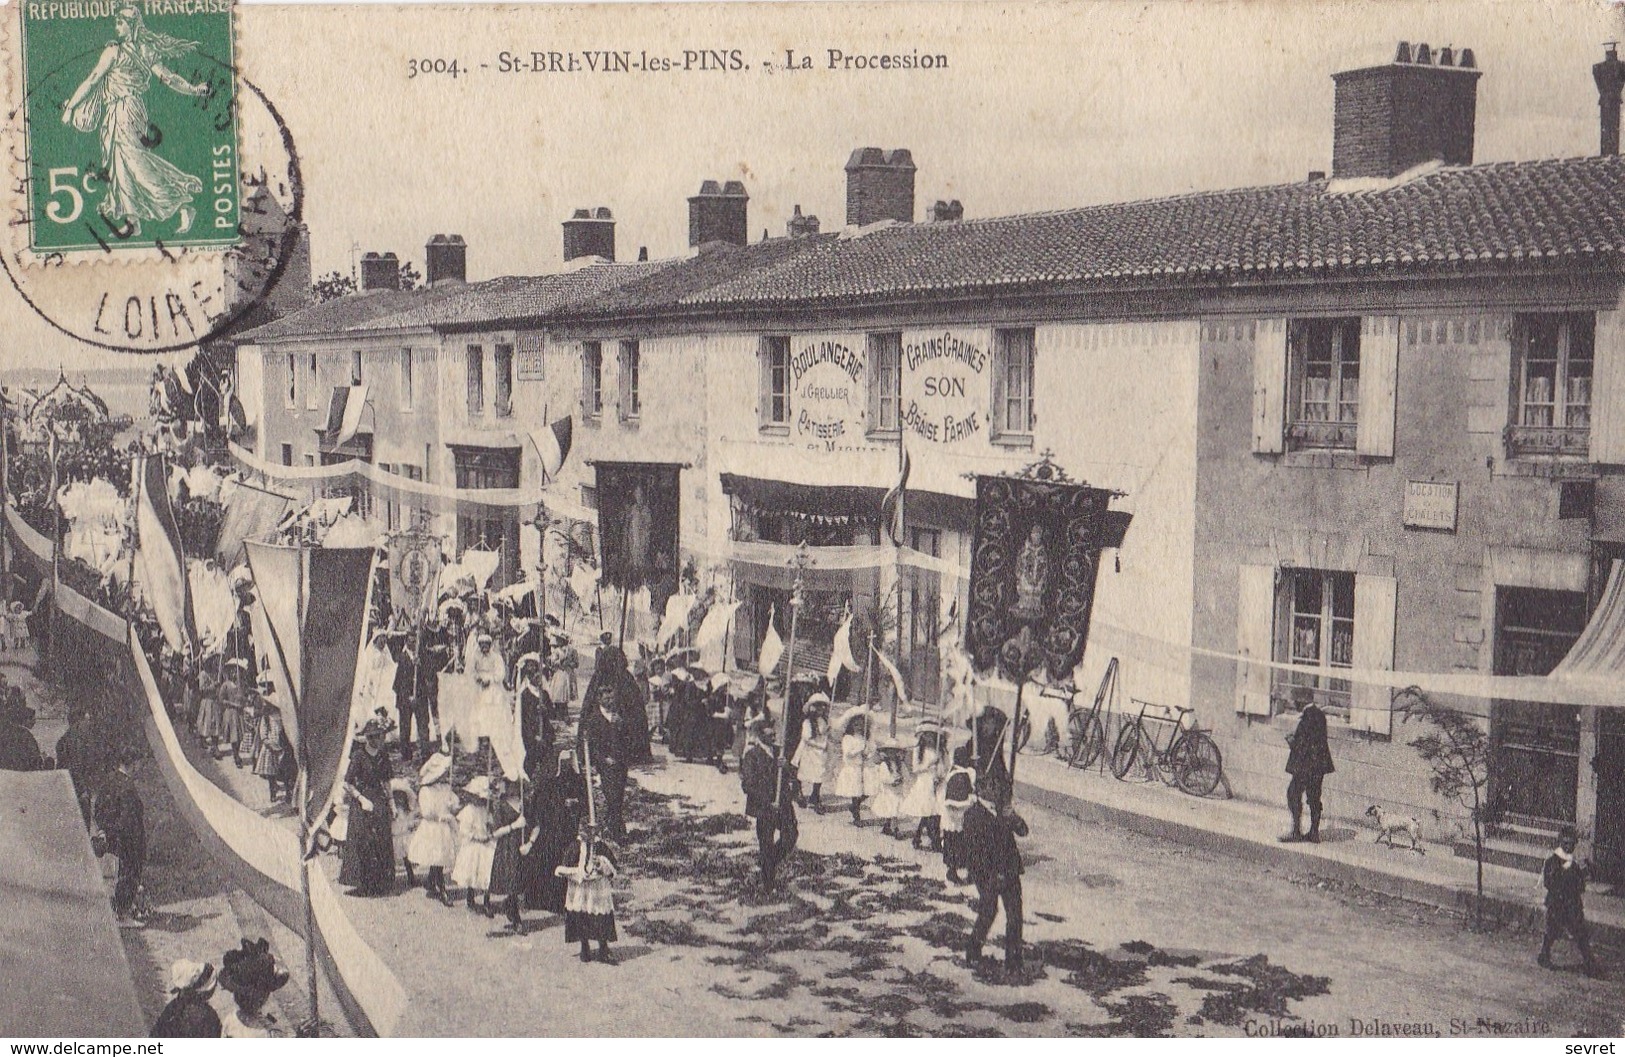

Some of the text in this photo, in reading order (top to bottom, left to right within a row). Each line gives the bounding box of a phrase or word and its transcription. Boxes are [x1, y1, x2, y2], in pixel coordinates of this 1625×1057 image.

[212, 143, 233, 229] POSTES
[792, 341, 864, 391] BOULANGERIE
[906, 331, 986, 374] GRAINS GRAINES
[924, 376, 966, 398] SON
[798, 409, 845, 438] PATISSERIE
[903, 400, 980, 444] BRAISE FARINE
